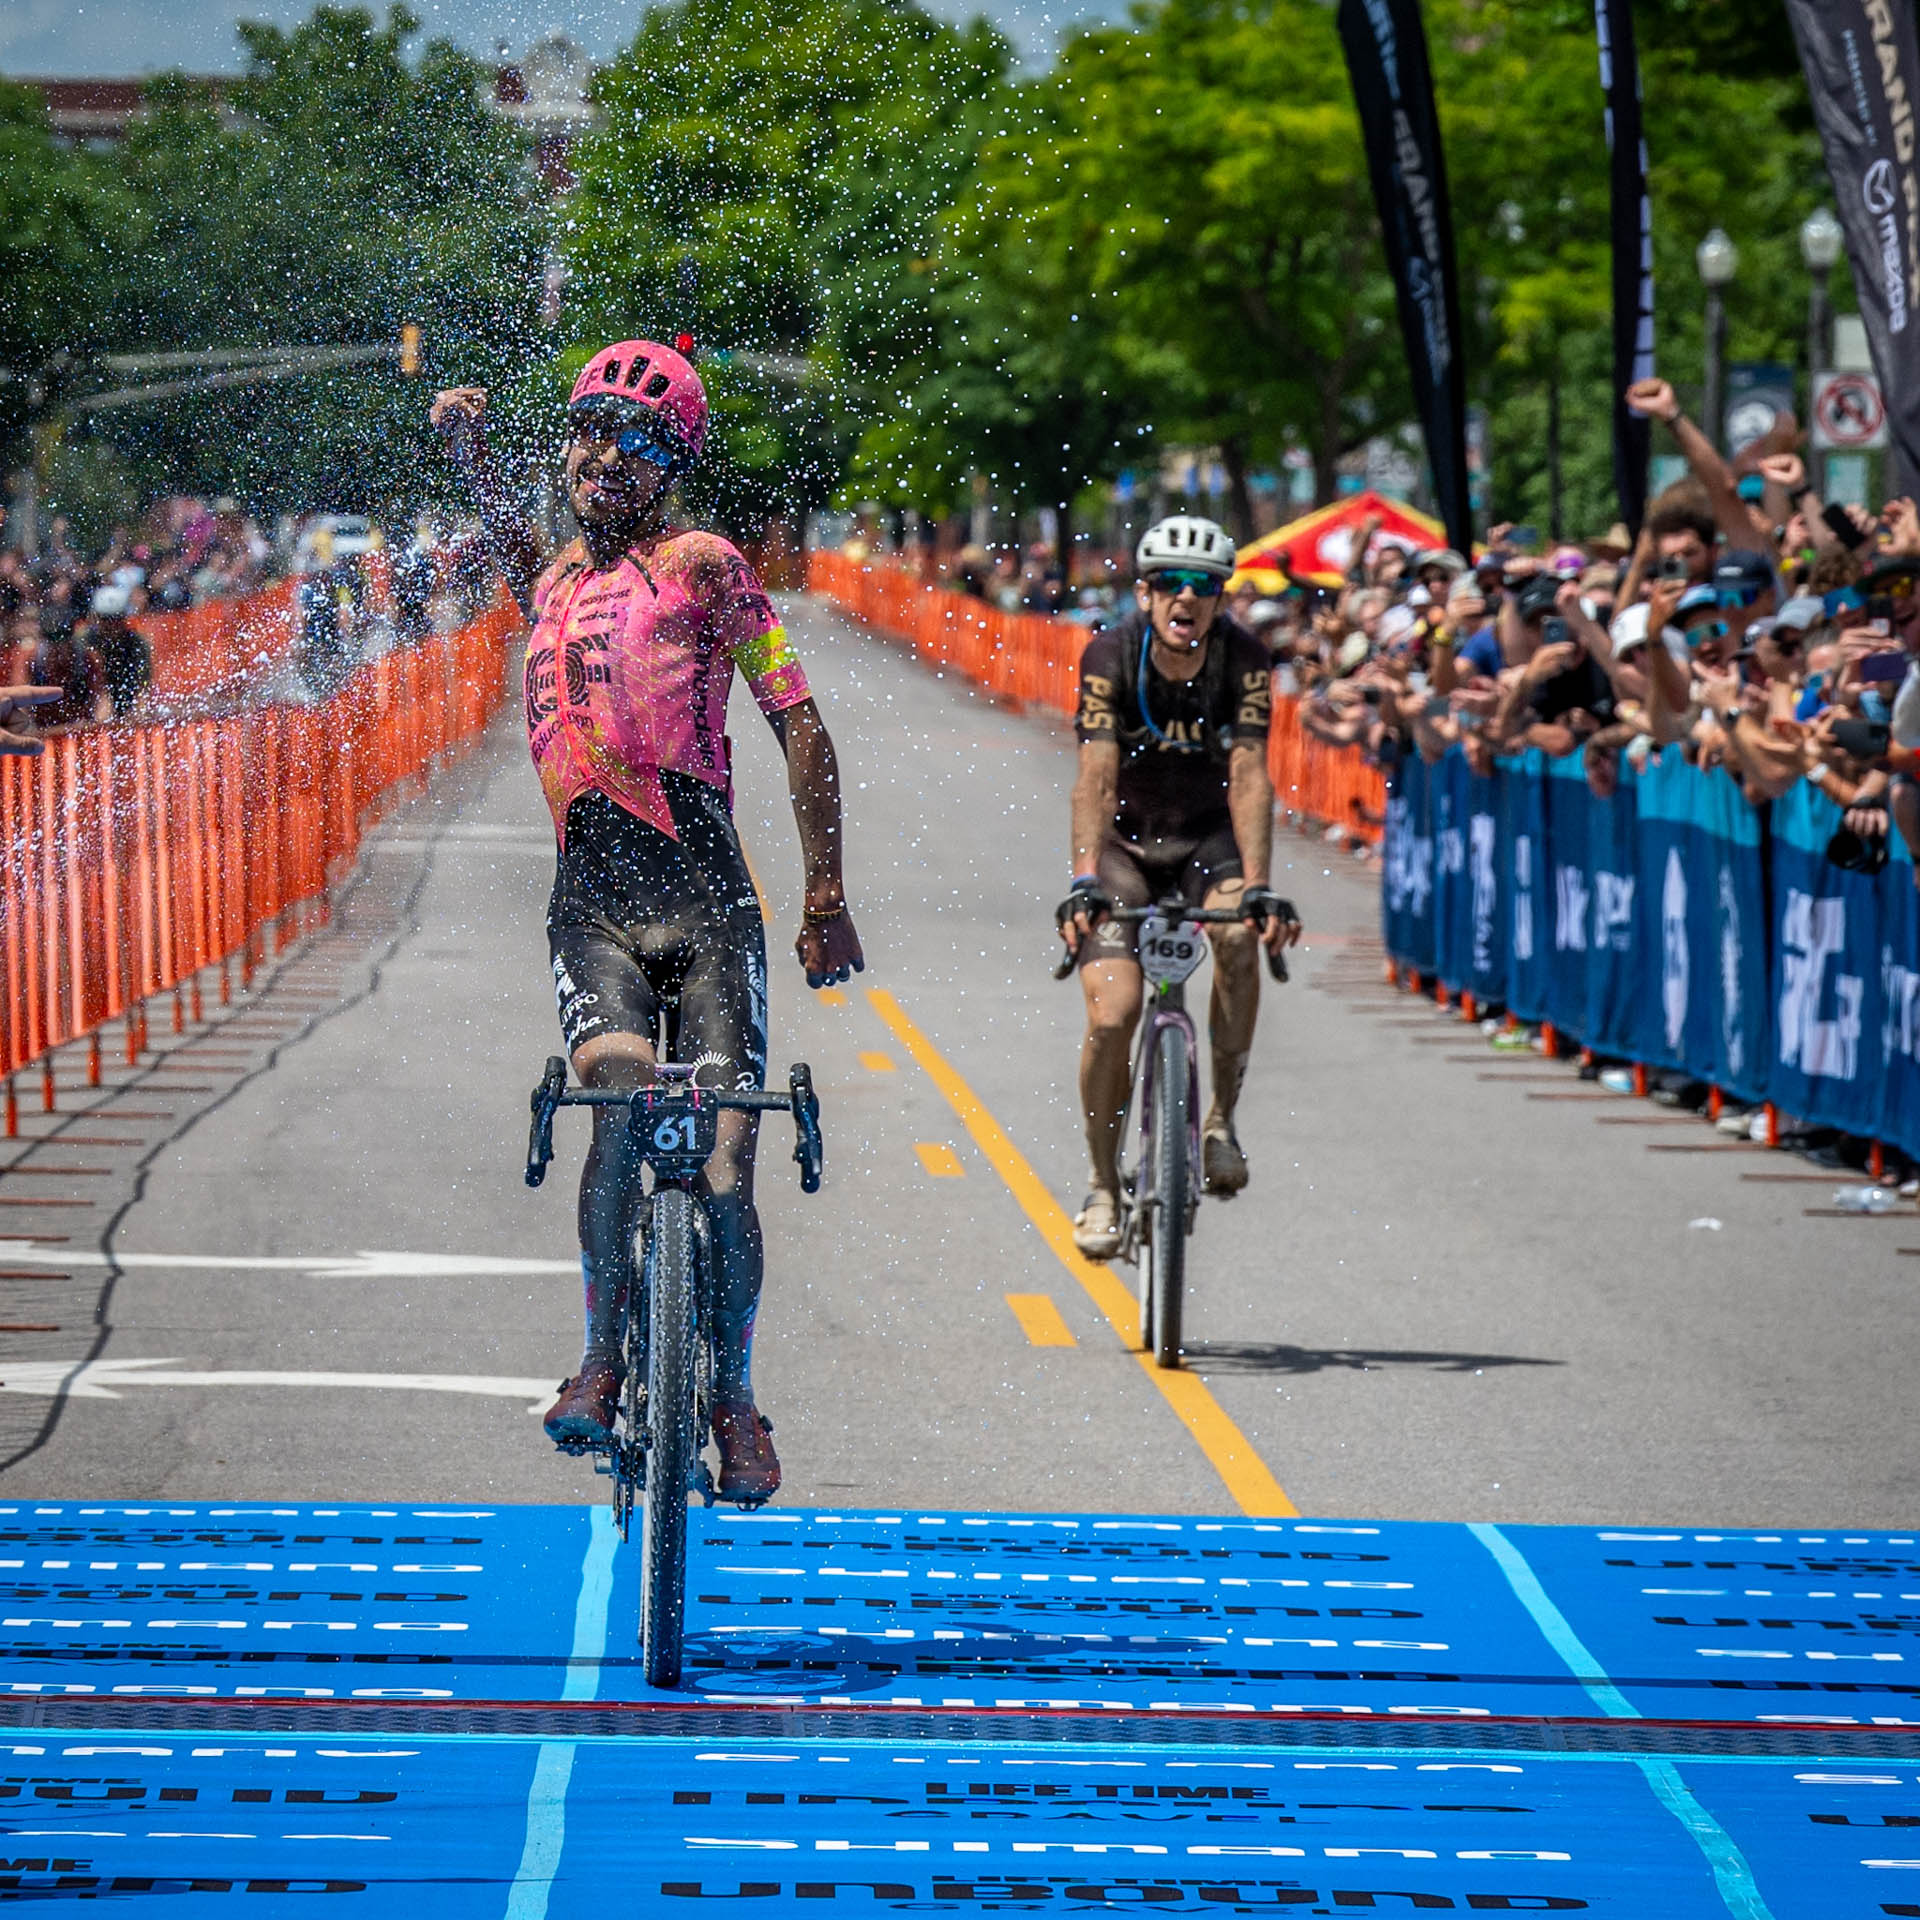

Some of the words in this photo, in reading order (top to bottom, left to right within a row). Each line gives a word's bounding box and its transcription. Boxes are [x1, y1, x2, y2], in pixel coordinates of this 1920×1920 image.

[1083, 673, 1114, 729] PAS
[1239, 669, 1271, 726] PAS
[1142, 937, 1193, 960] 169
[653, 1115, 697, 1151] 61
[926, 1782, 1072, 1797] LIFE
[1083, 1784, 1269, 1800] TIME
[683, 1837, 1573, 1862] SHIMANO
[660, 1882, 1590, 1910] UNBOUND
